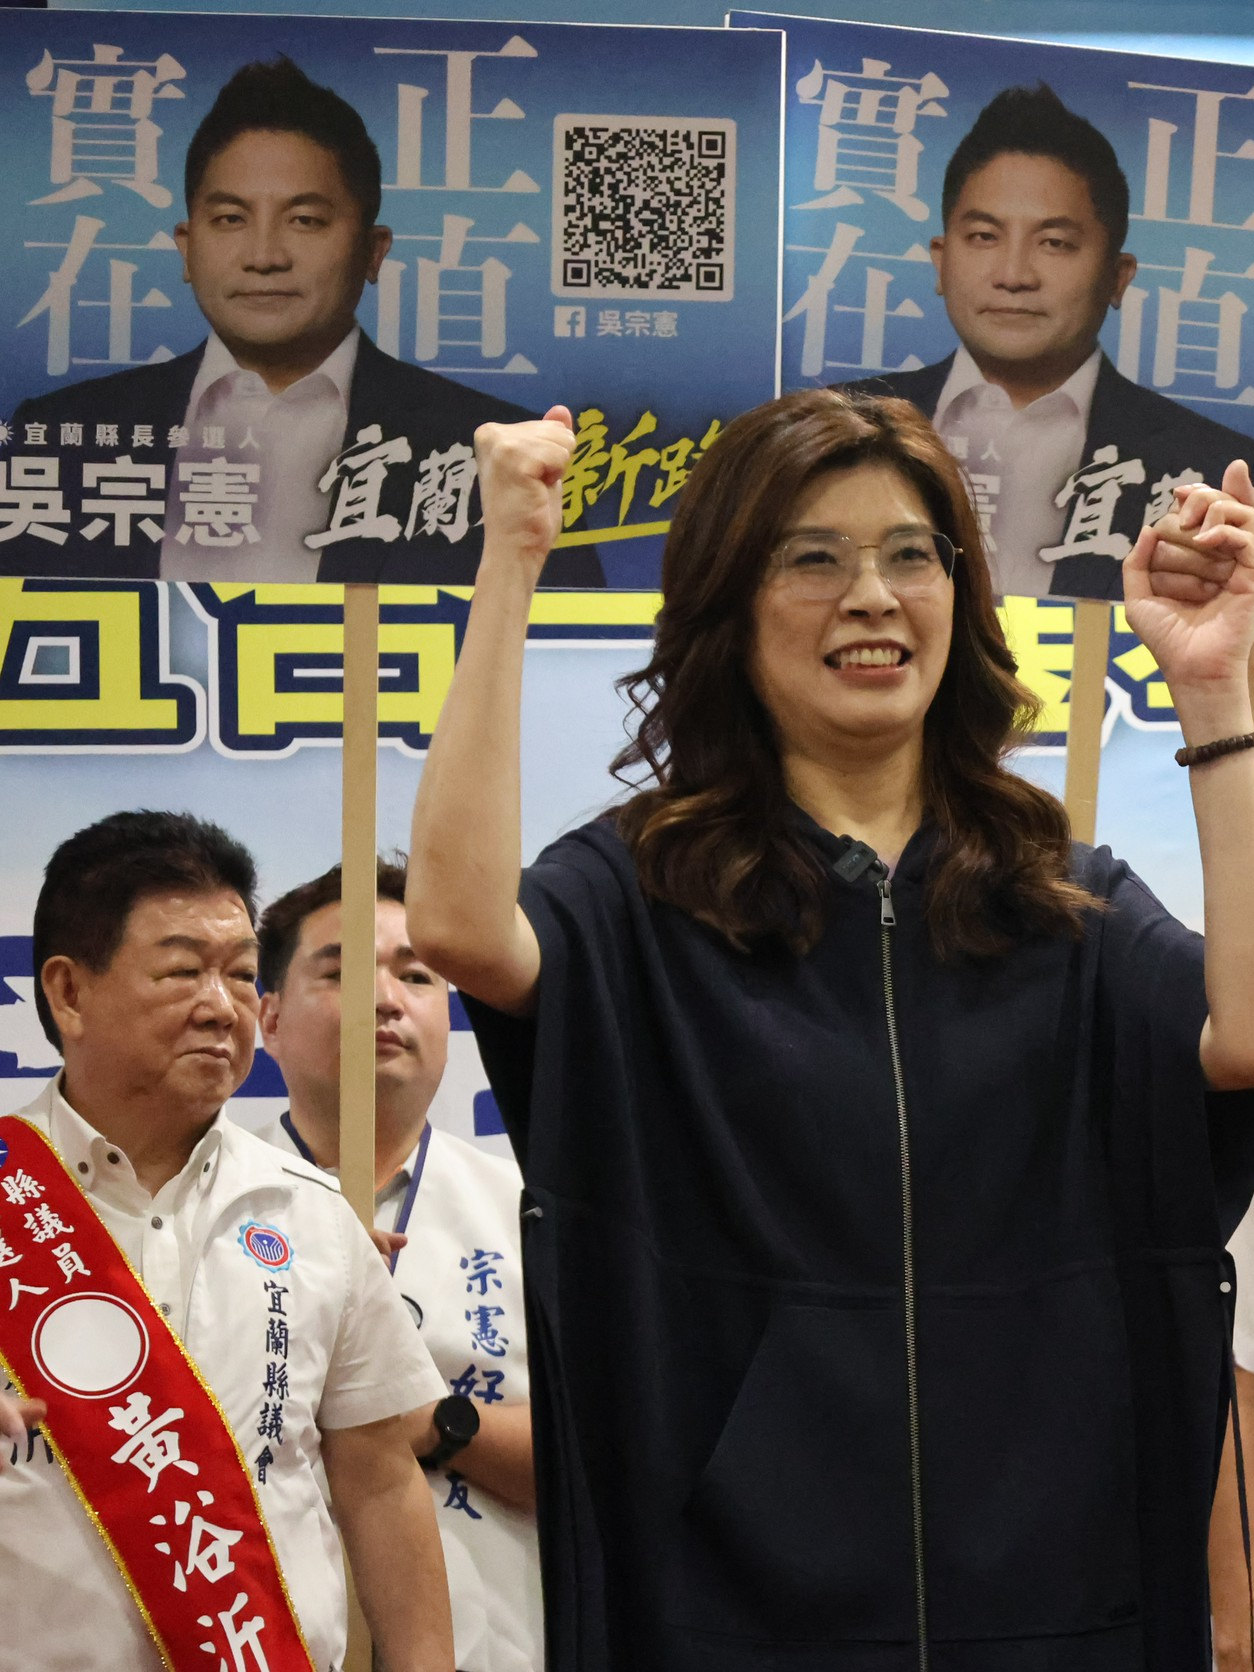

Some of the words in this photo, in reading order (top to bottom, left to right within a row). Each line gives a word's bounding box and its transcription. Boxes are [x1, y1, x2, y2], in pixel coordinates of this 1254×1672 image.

[17, 44, 188, 377] 實在
[373, 35, 541, 376] 正直
[596, 310, 678, 338] 吳宗憲
[781, 58, 950, 378] 實在
[0, 454, 262, 547] 吳宗憲
[24, 421, 261, 449] 宜蘭縣長參選人
[1, 1169, 91, 1284] 縣議員
[253, 1280, 290, 1486] 宜蘭縣議會
[443, 1248, 509, 1520] 宗憲好友
[107, 1391, 266, 1672] 黃浴沂
